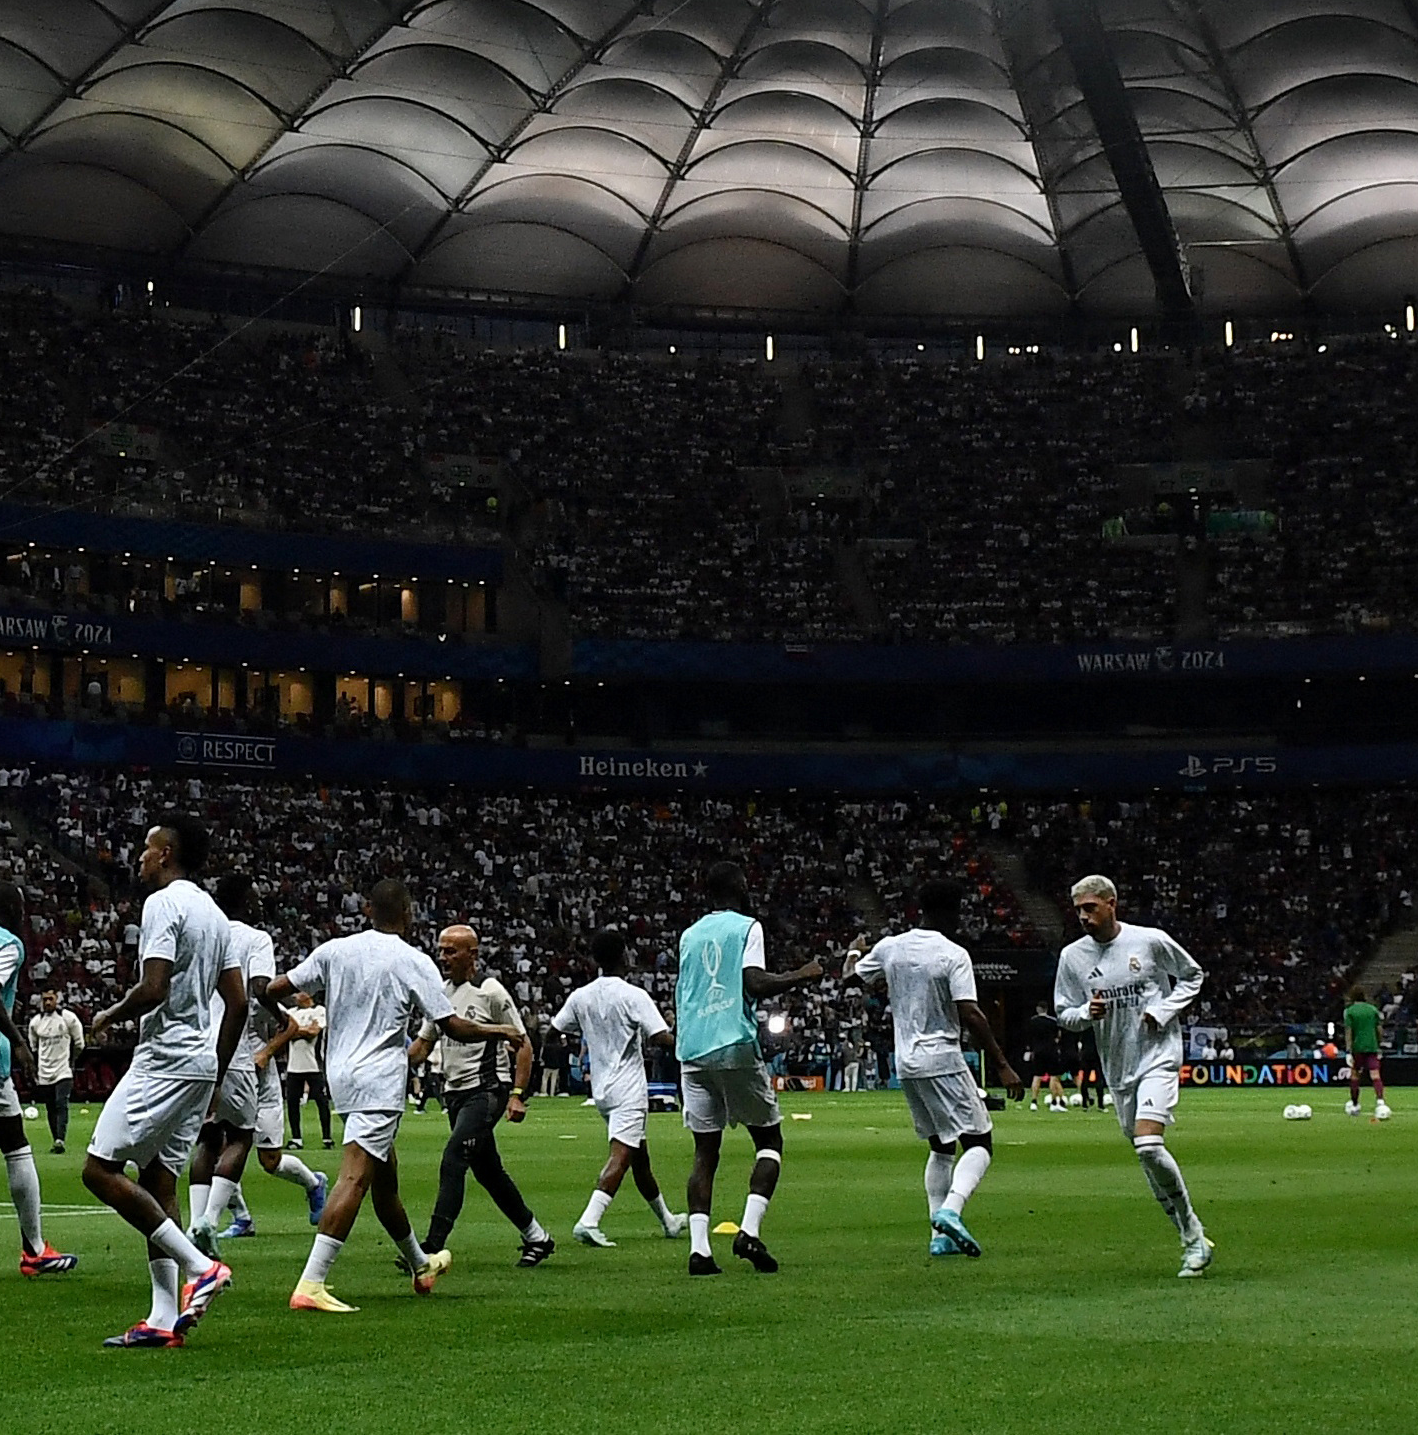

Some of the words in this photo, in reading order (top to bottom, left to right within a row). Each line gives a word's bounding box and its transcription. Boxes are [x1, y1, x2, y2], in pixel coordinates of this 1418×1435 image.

[74, 622, 113, 645] 2024
[1078, 653, 1151, 672] WARSAW
[1181, 651, 1225, 670] 2024
[203, 740, 276, 762] RESPECT
[579, 756, 688, 777] Heineken
[1212, 757, 1277, 774] PS5
[1179, 1063, 1329, 1085] FOUNDATION
